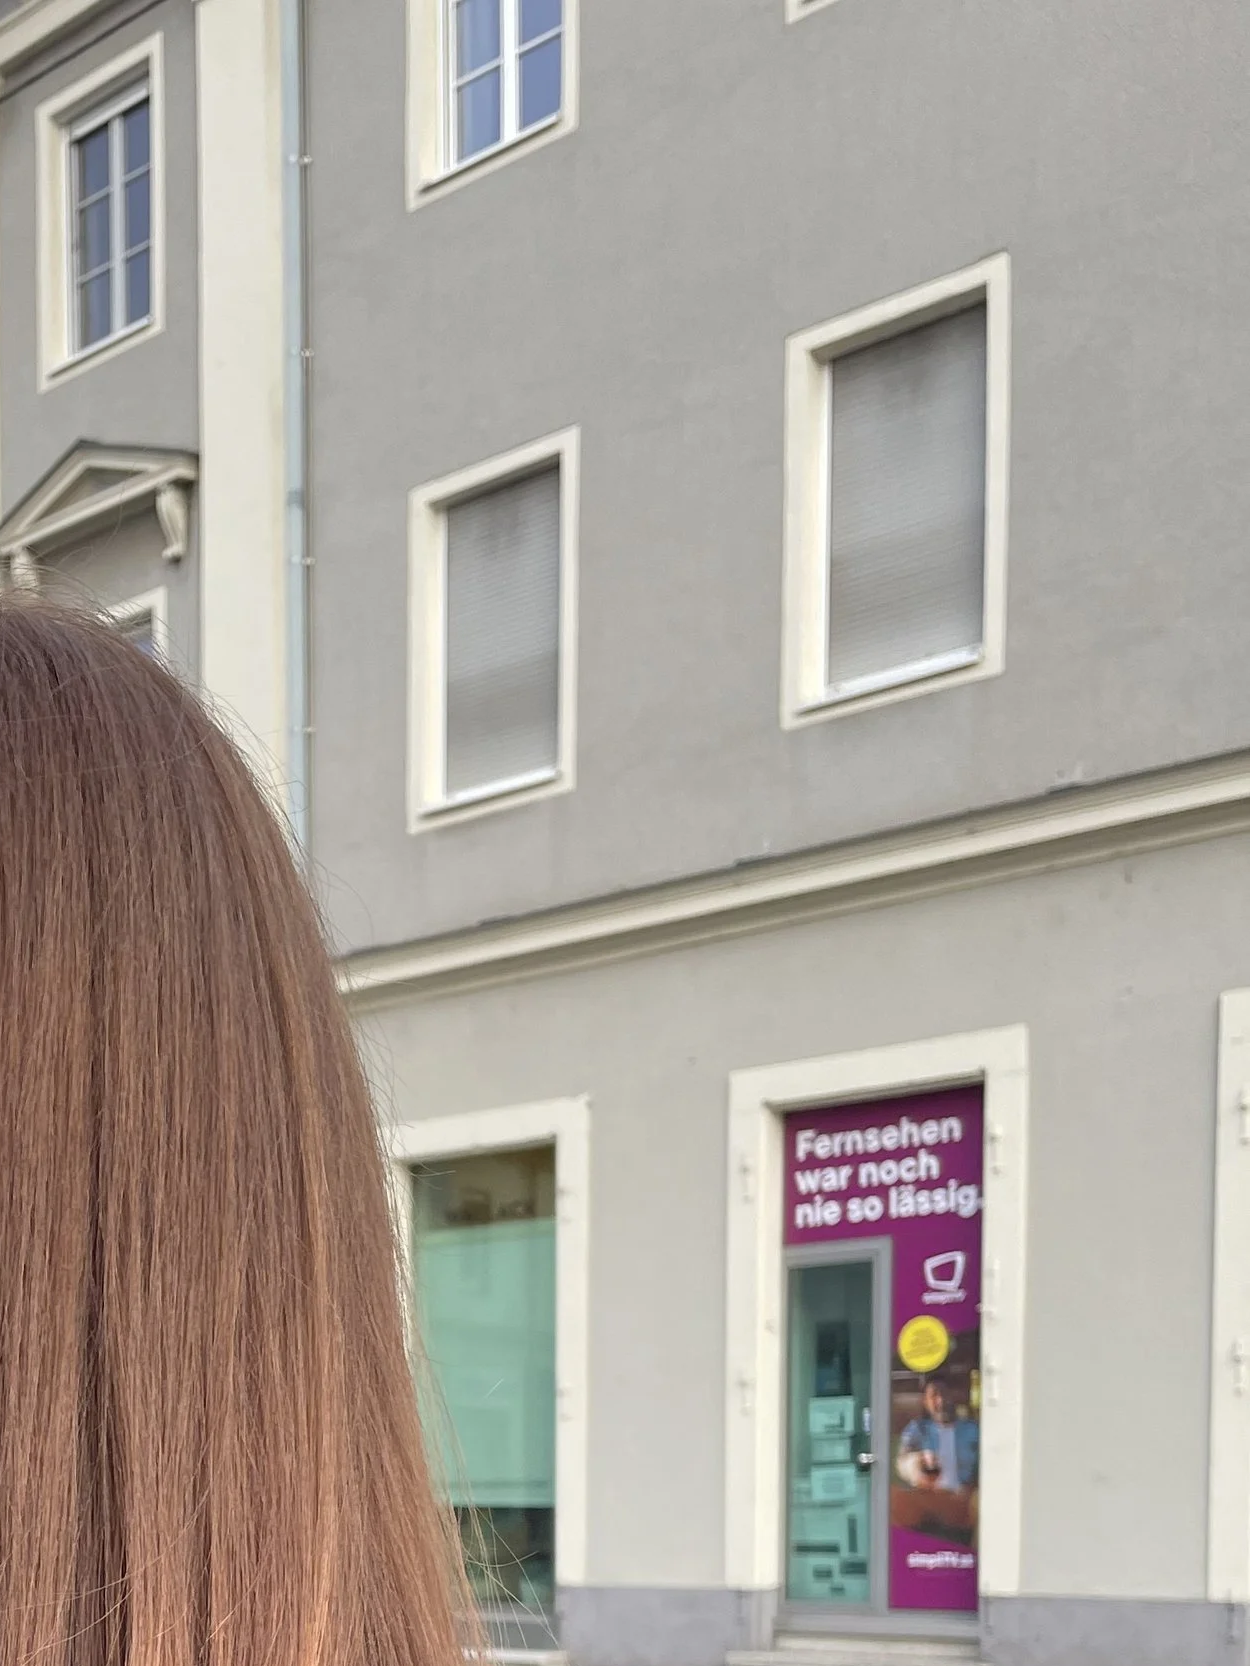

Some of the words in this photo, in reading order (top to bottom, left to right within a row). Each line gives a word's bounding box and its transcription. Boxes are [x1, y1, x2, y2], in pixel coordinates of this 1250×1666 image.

[795, 1116, 962, 1162] Fernsehen
[795, 1164, 852, 1195] war
[858, 1149, 940, 1188] noch
[795, 1195, 841, 1229] nie
[846, 1195, 884, 1223] so
